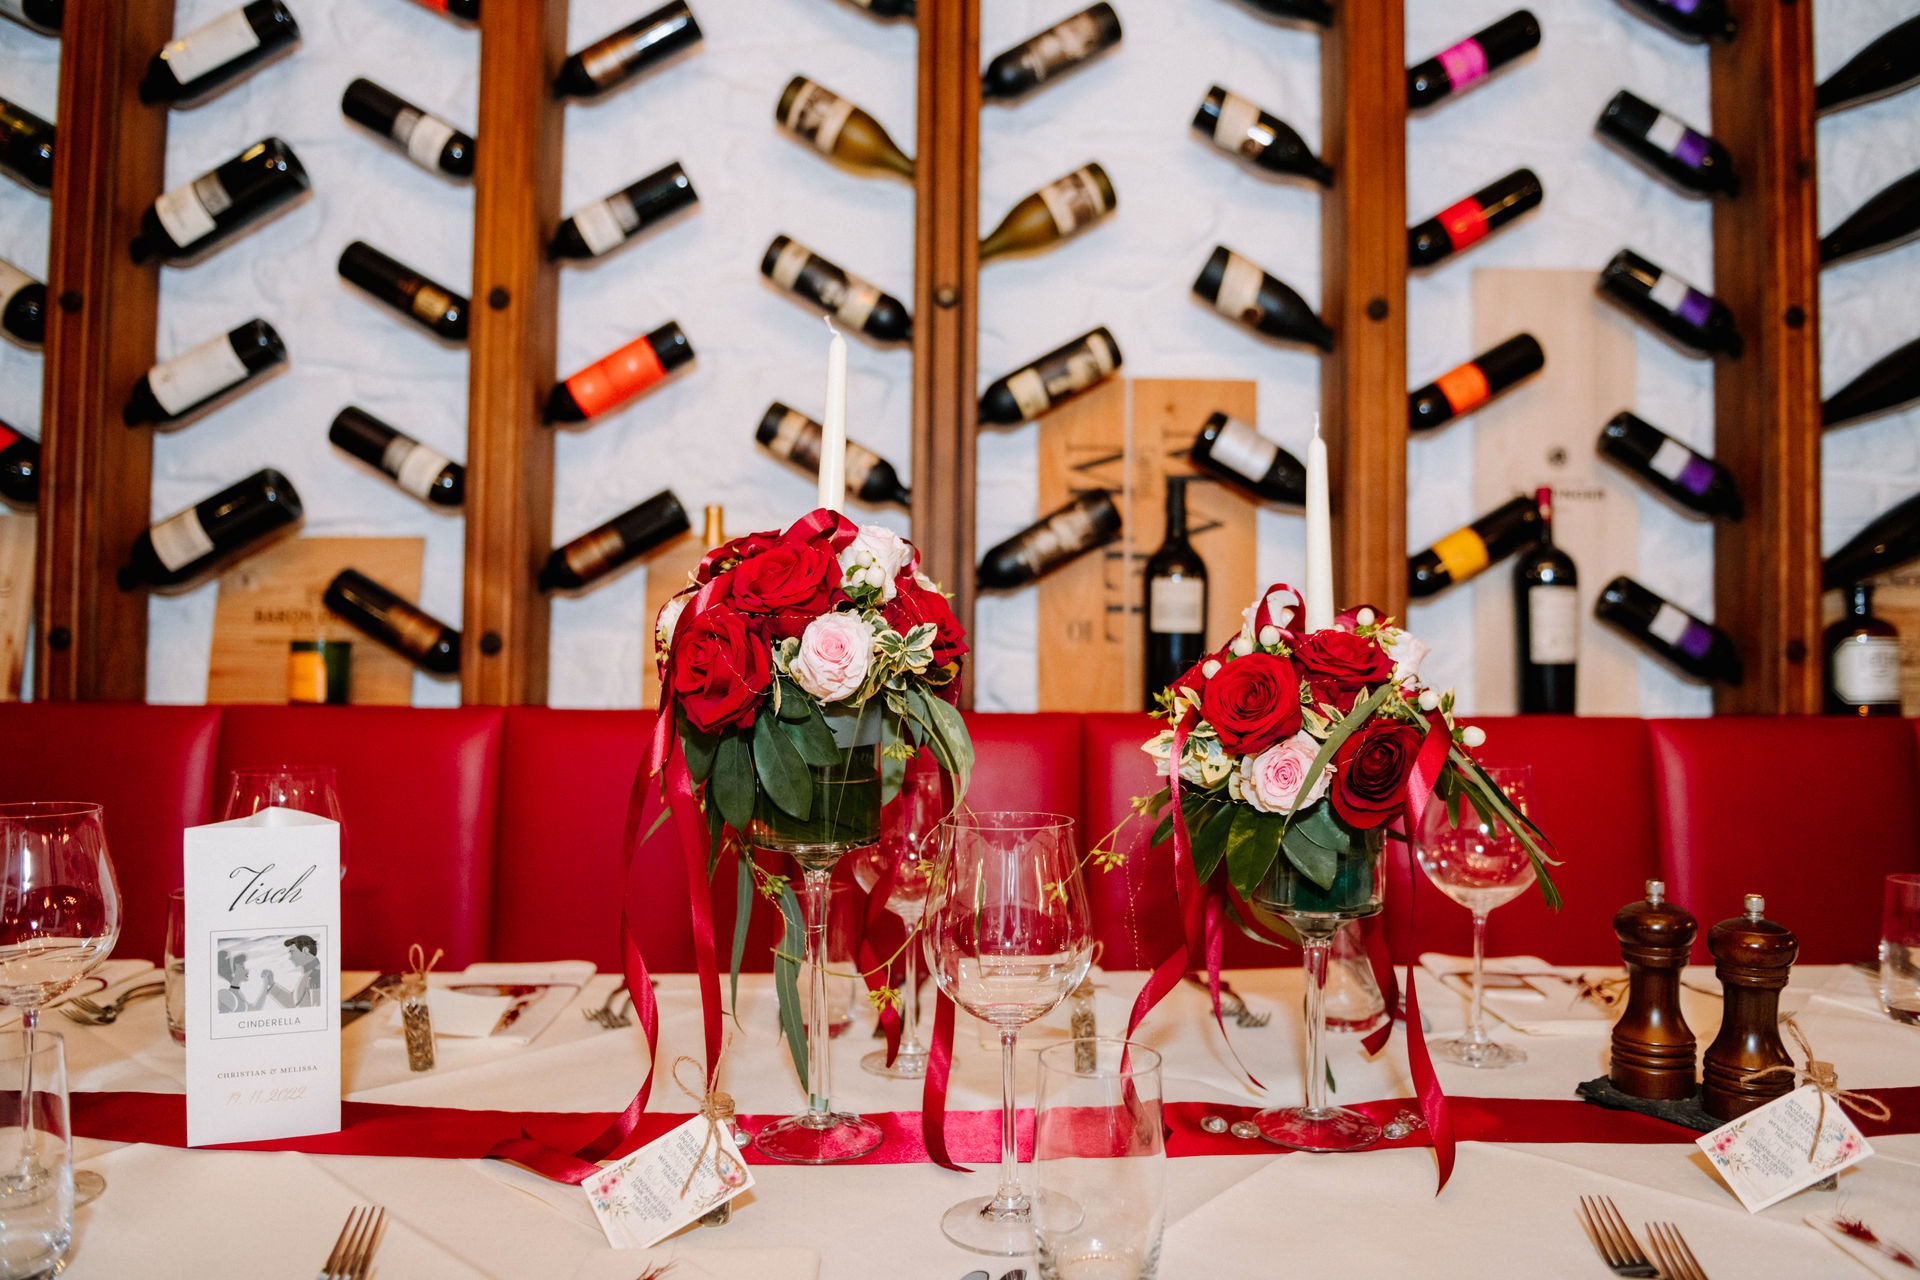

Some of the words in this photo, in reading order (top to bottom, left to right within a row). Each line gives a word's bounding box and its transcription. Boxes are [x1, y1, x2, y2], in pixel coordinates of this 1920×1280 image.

[228, 863, 316, 912] Tisch
[238, 1017, 301, 1029] CINDERELLA
[217, 1070, 267, 1079] CHRISTIAN
[280, 1065, 318, 1073] MELISSA
